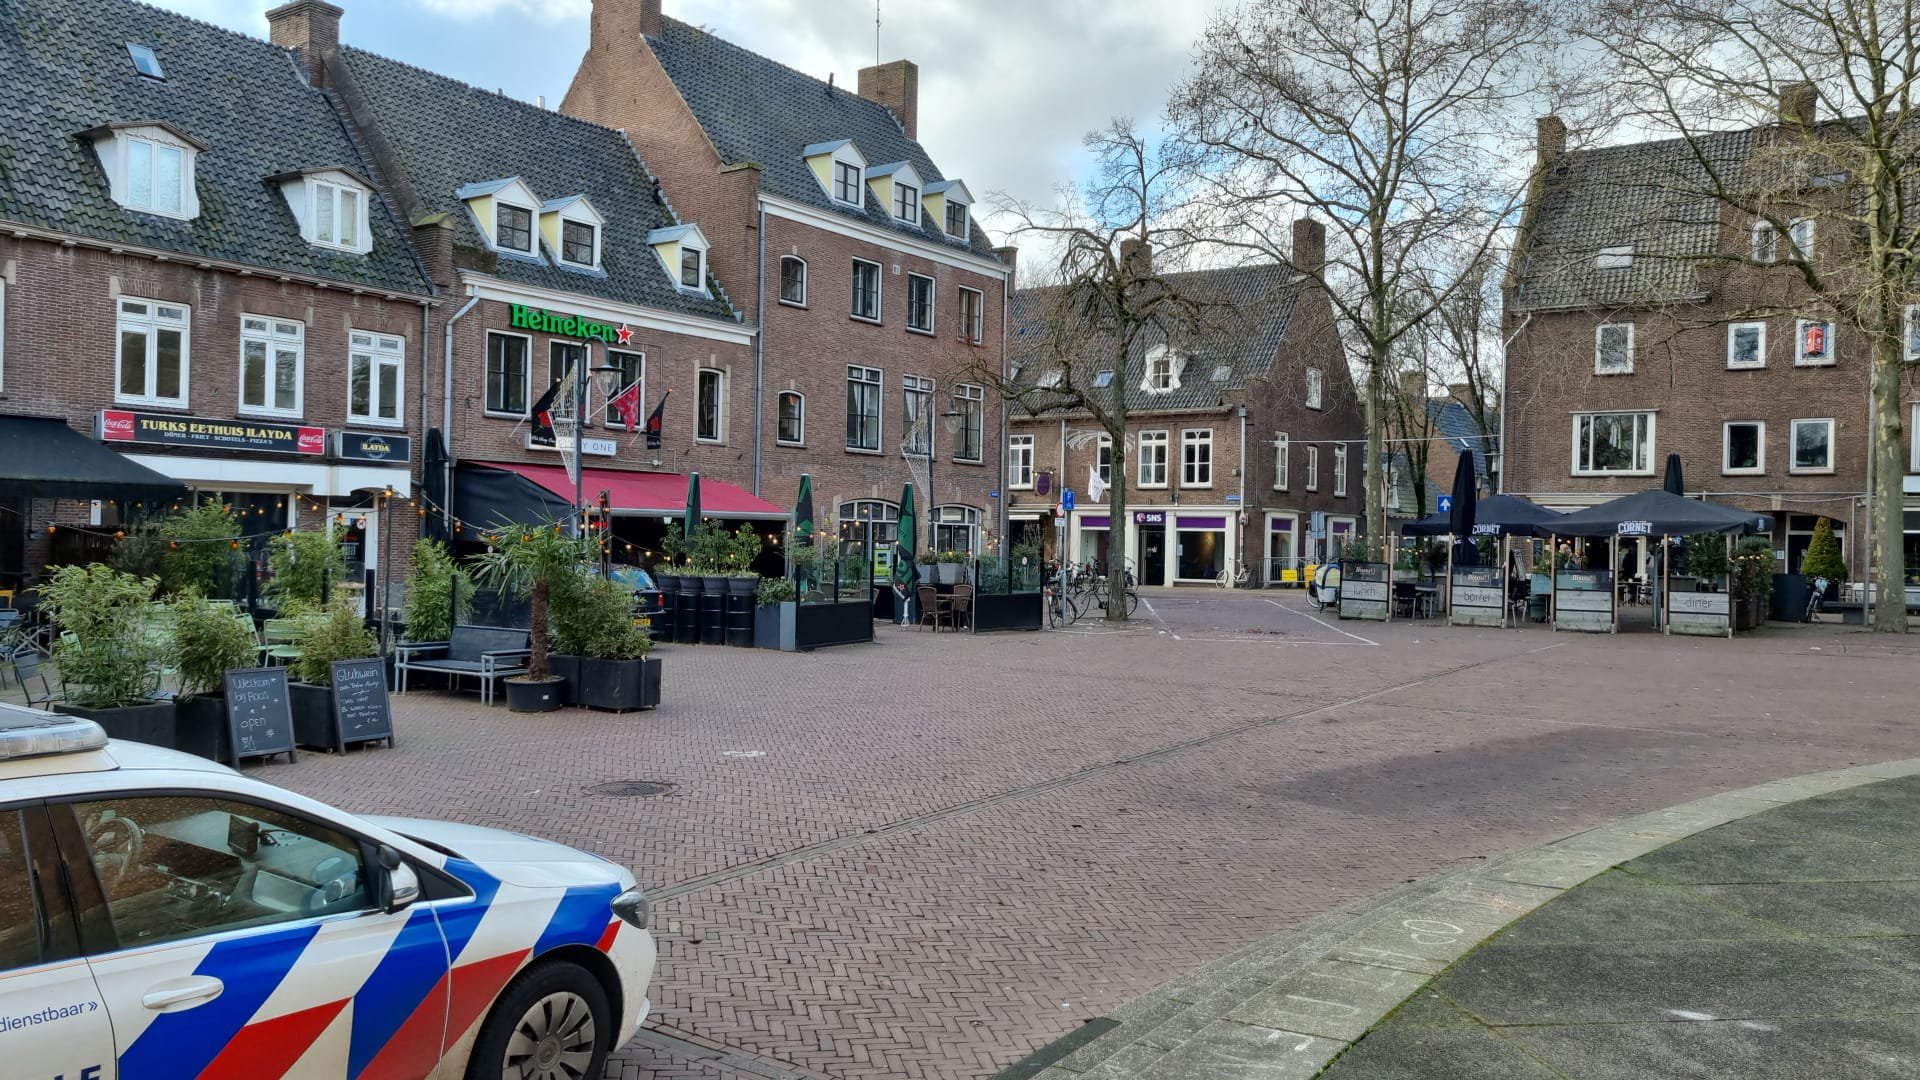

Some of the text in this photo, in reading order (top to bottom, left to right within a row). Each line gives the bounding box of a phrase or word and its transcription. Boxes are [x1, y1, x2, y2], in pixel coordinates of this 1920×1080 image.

[511, 303, 614, 342] Heineken
[141, 419, 293, 441] TURKS EETHUIS ILAYDA
[362, 443, 390, 452] ILAYDA
[592, 443, 613, 452] ONE
[1146, 514, 1162, 522] SNS
[1472, 524, 1501, 535] CORNET
[1618, 521, 1653, 534] CORNET
[1353, 584, 1376, 597] lunch
[1463, 590, 1490, 602] borrel
[1685, 596, 1713, 609] diner
